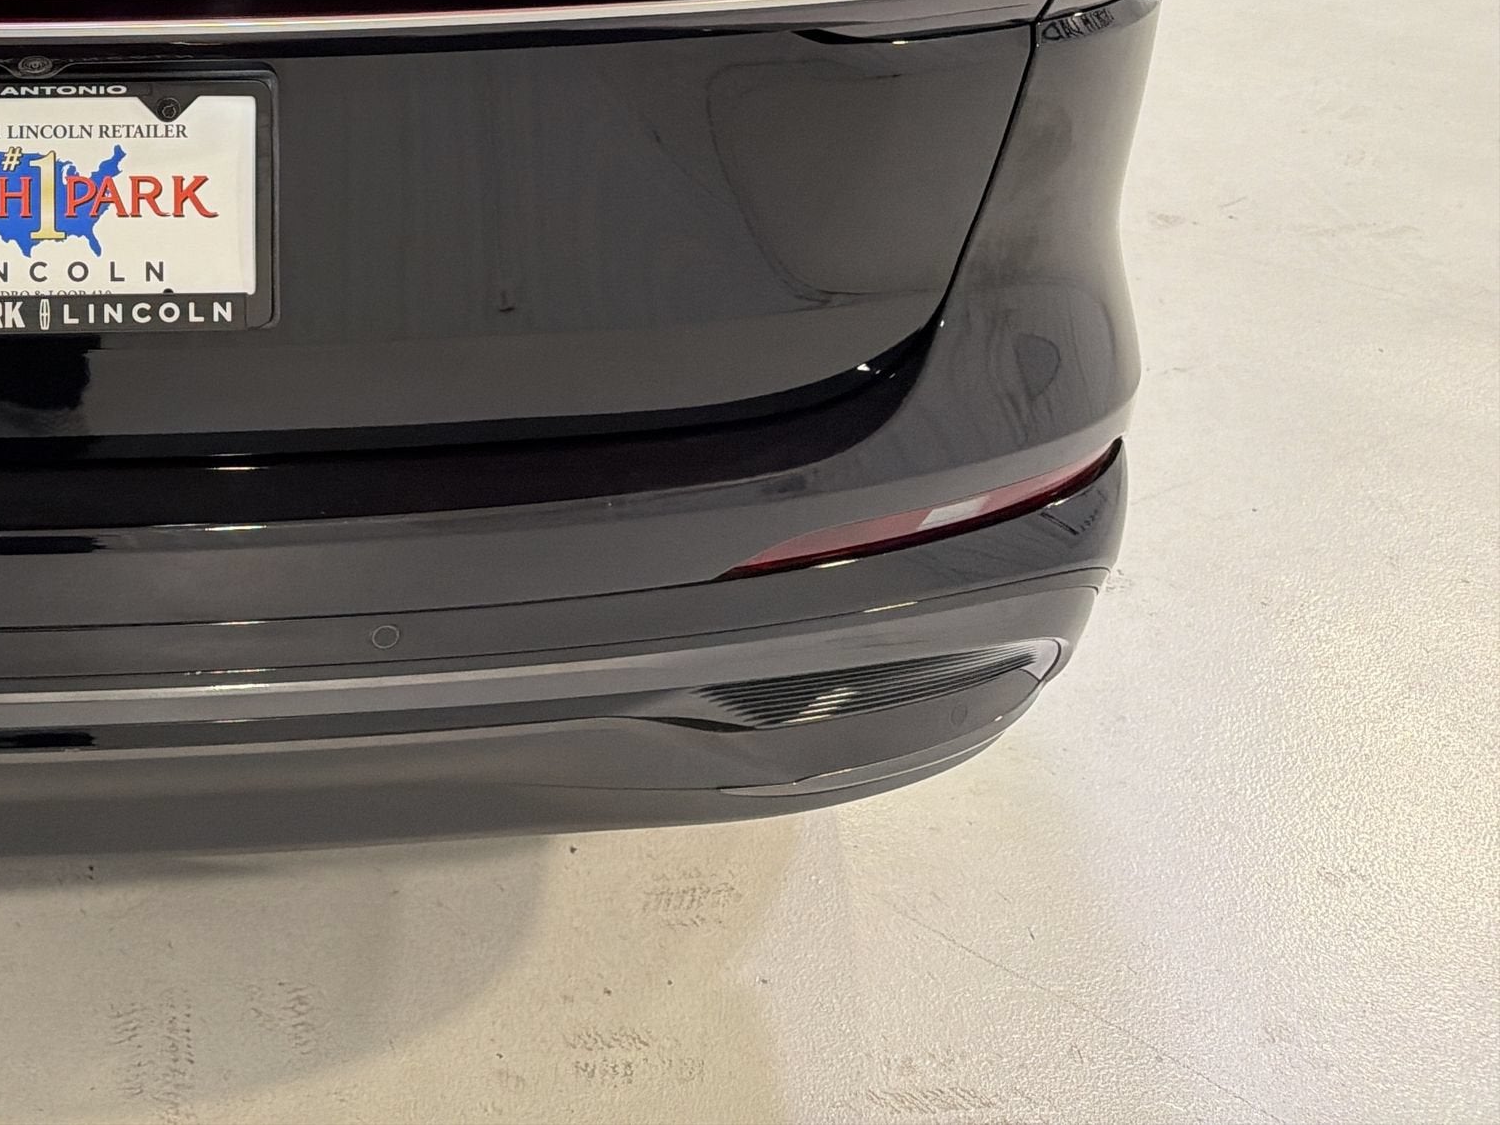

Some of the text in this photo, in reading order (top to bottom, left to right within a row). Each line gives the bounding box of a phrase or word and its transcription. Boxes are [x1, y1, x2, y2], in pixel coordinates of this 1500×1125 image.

[0, 85, 128, 96] ANTONIO
[7, 125, 93, 140] LINCOLN
[99, 124, 188, 139] RETAILER
[64, 175, 219, 218] PARK
[62, 301, 232, 324] LINCOLN
